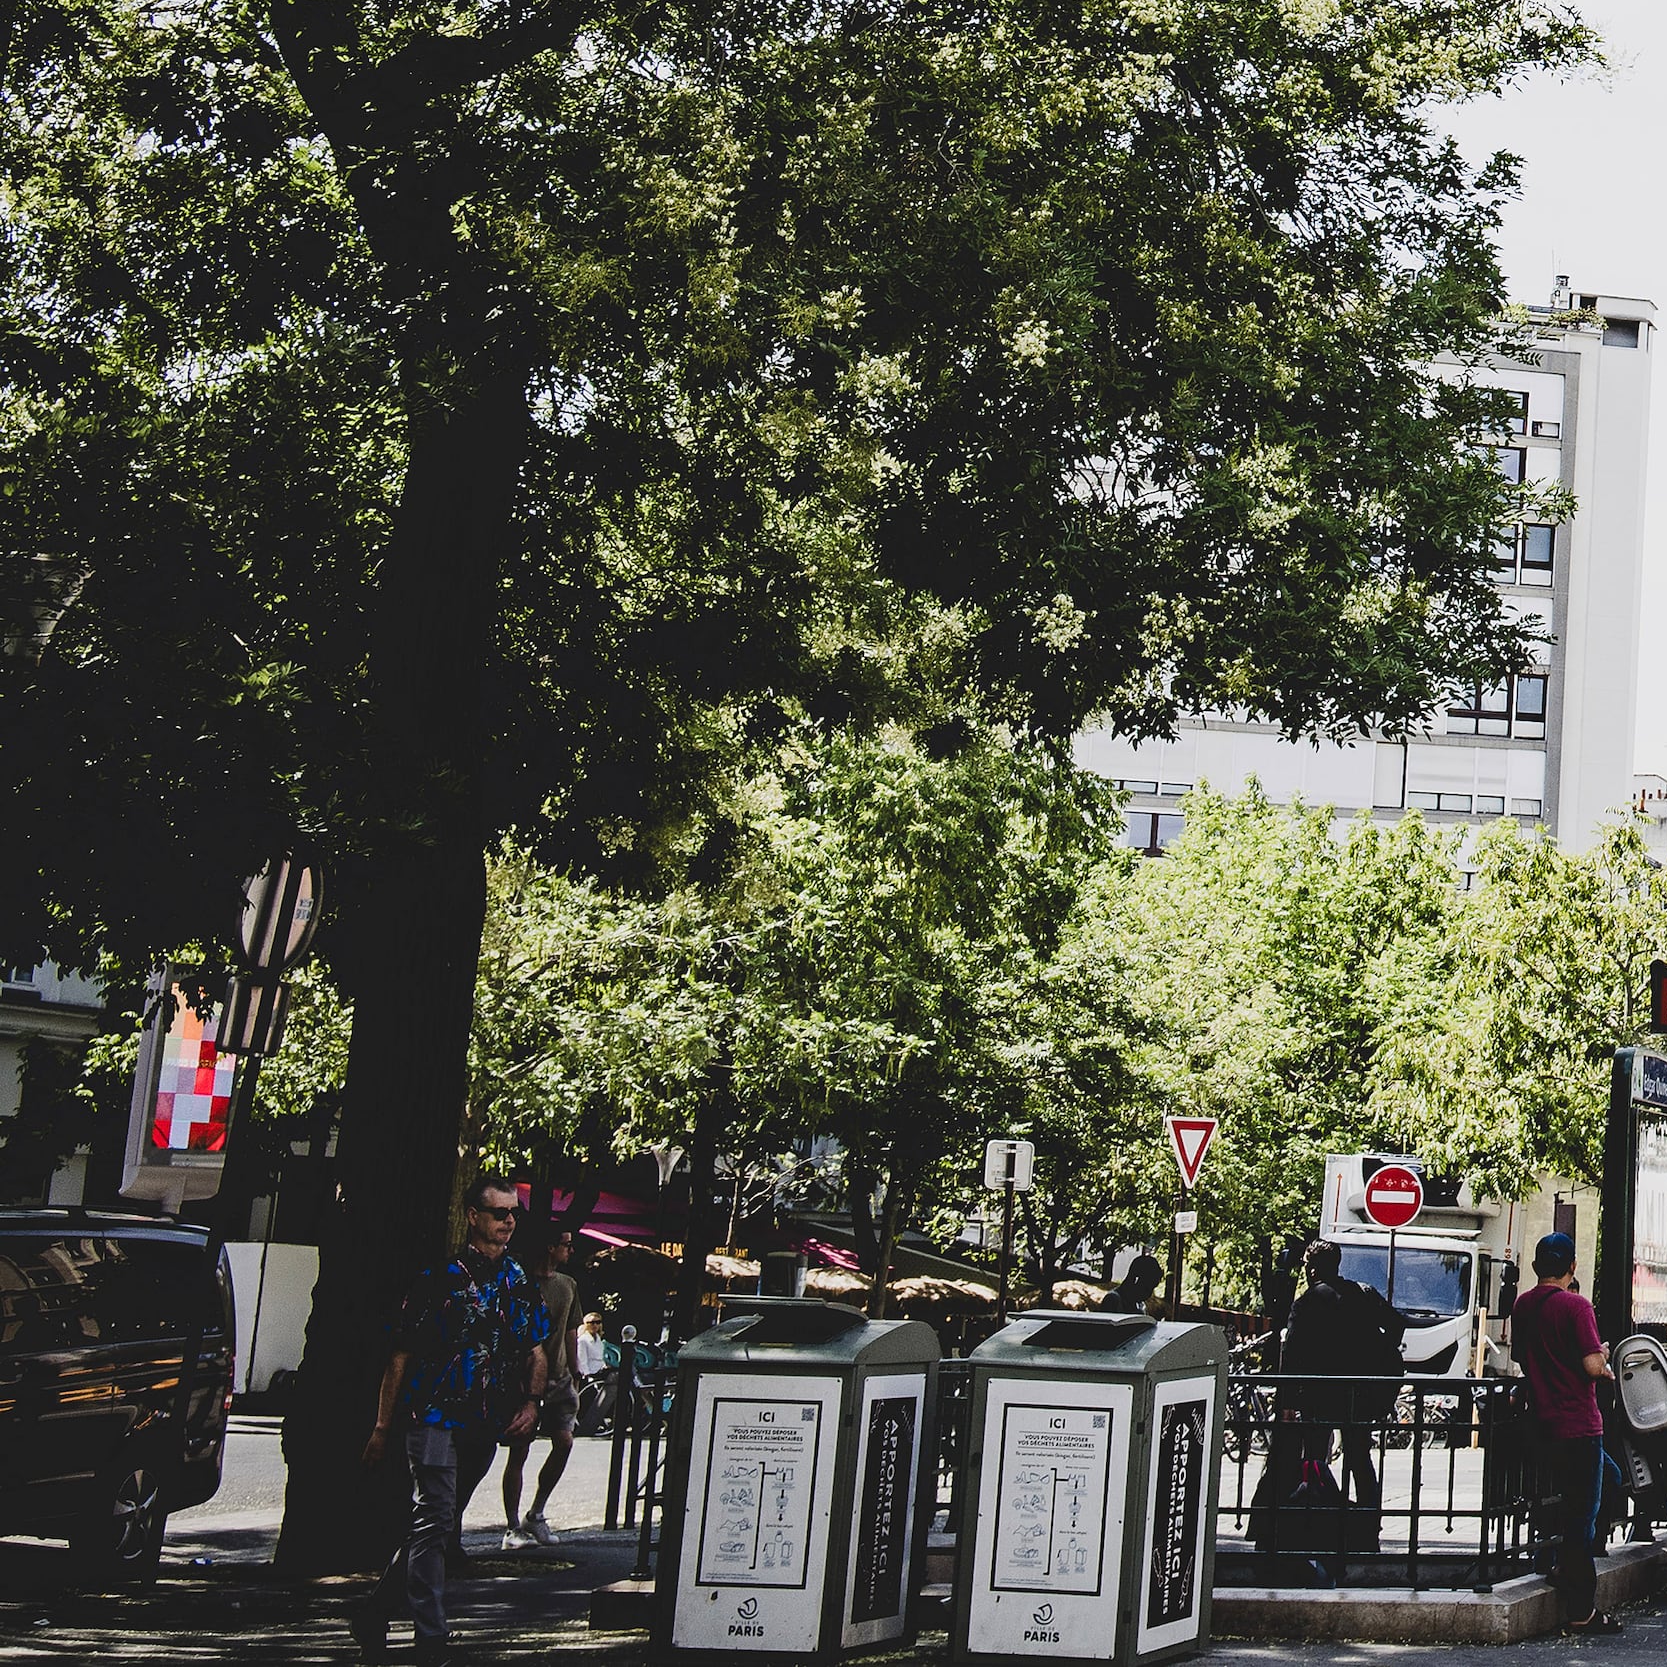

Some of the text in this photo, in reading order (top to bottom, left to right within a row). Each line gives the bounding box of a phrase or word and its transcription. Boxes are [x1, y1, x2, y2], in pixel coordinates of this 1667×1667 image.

[758, 1412, 775, 1423] ICI
[1049, 1418, 1066, 1429] ICI
[882, 1419, 890, 1447] VOS
[1173, 1424, 1182, 1452] VOS
[1055, 1441, 1095, 1449] ALIMENTAIRES
[878, 1419, 899, 1574] APPORTEZ ICI
[1171, 1423, 1190, 1579] APPORTEZ ICI
[1162, 1518, 1174, 1615] ALIMENTAIRES
[728, 1625, 764, 1637] PARIS
[1023, 1631, 1060, 1643] PARIS
